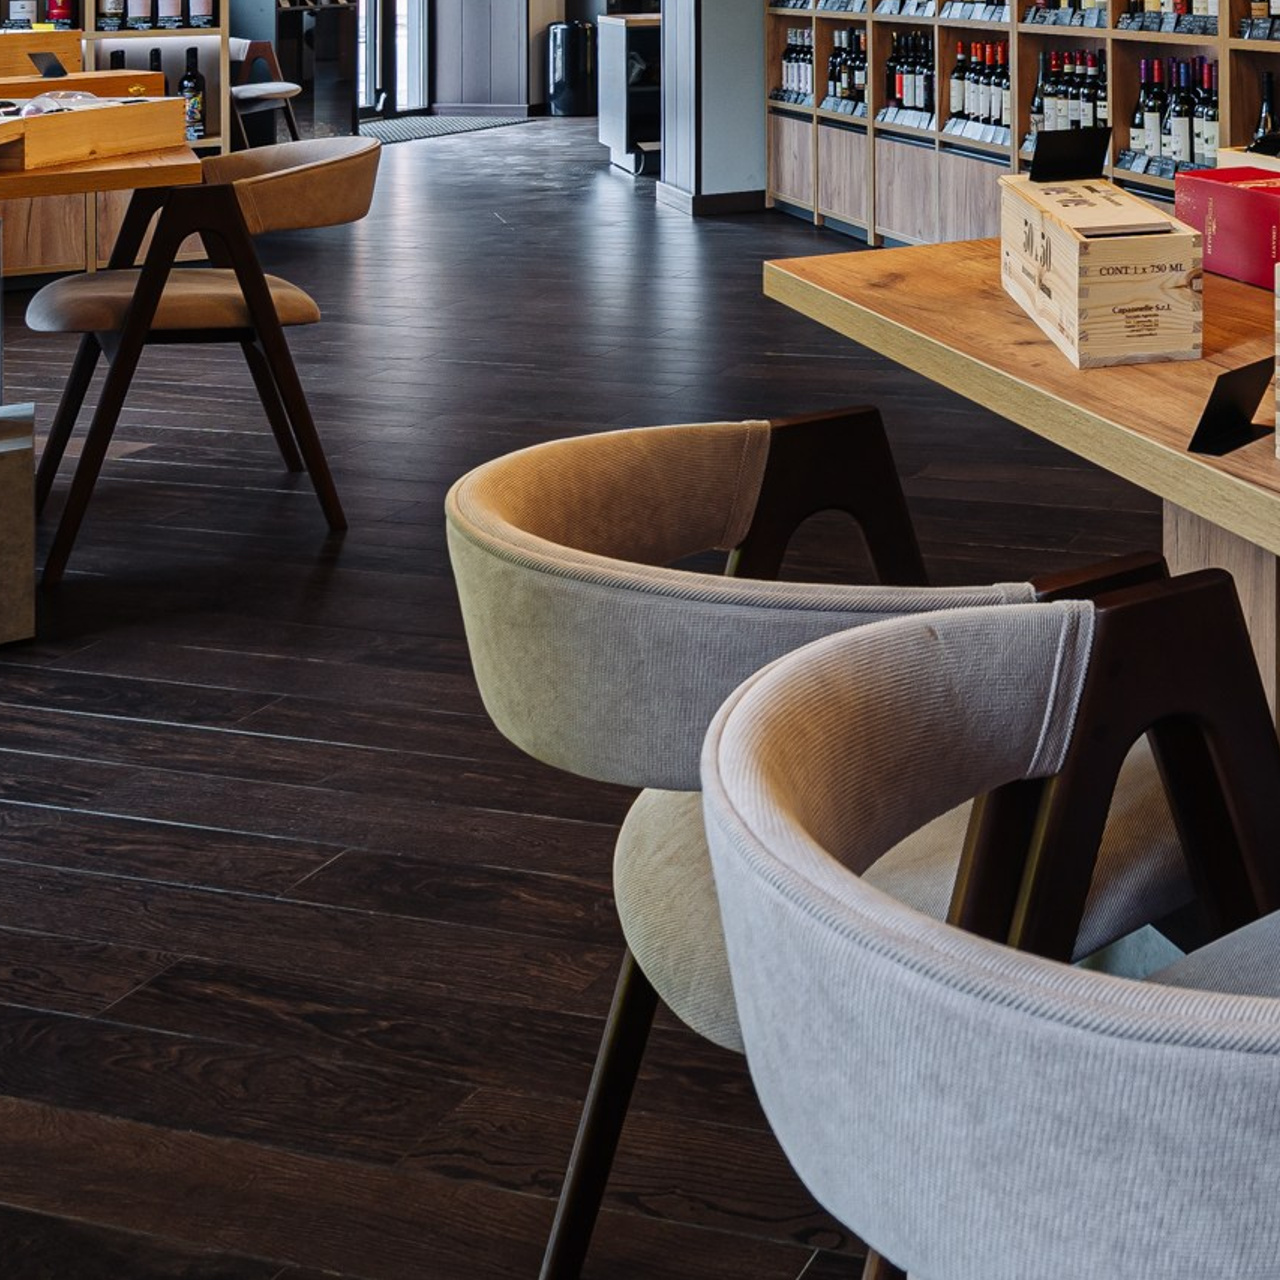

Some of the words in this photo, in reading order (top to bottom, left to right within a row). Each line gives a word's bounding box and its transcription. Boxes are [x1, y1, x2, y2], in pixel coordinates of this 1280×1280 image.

[1099, 266, 1129, 277] CONT
[1132, 266, 1138, 275] 1
[1150, 264, 1167, 274] 750
[1169, 263, 1186, 272] ML
